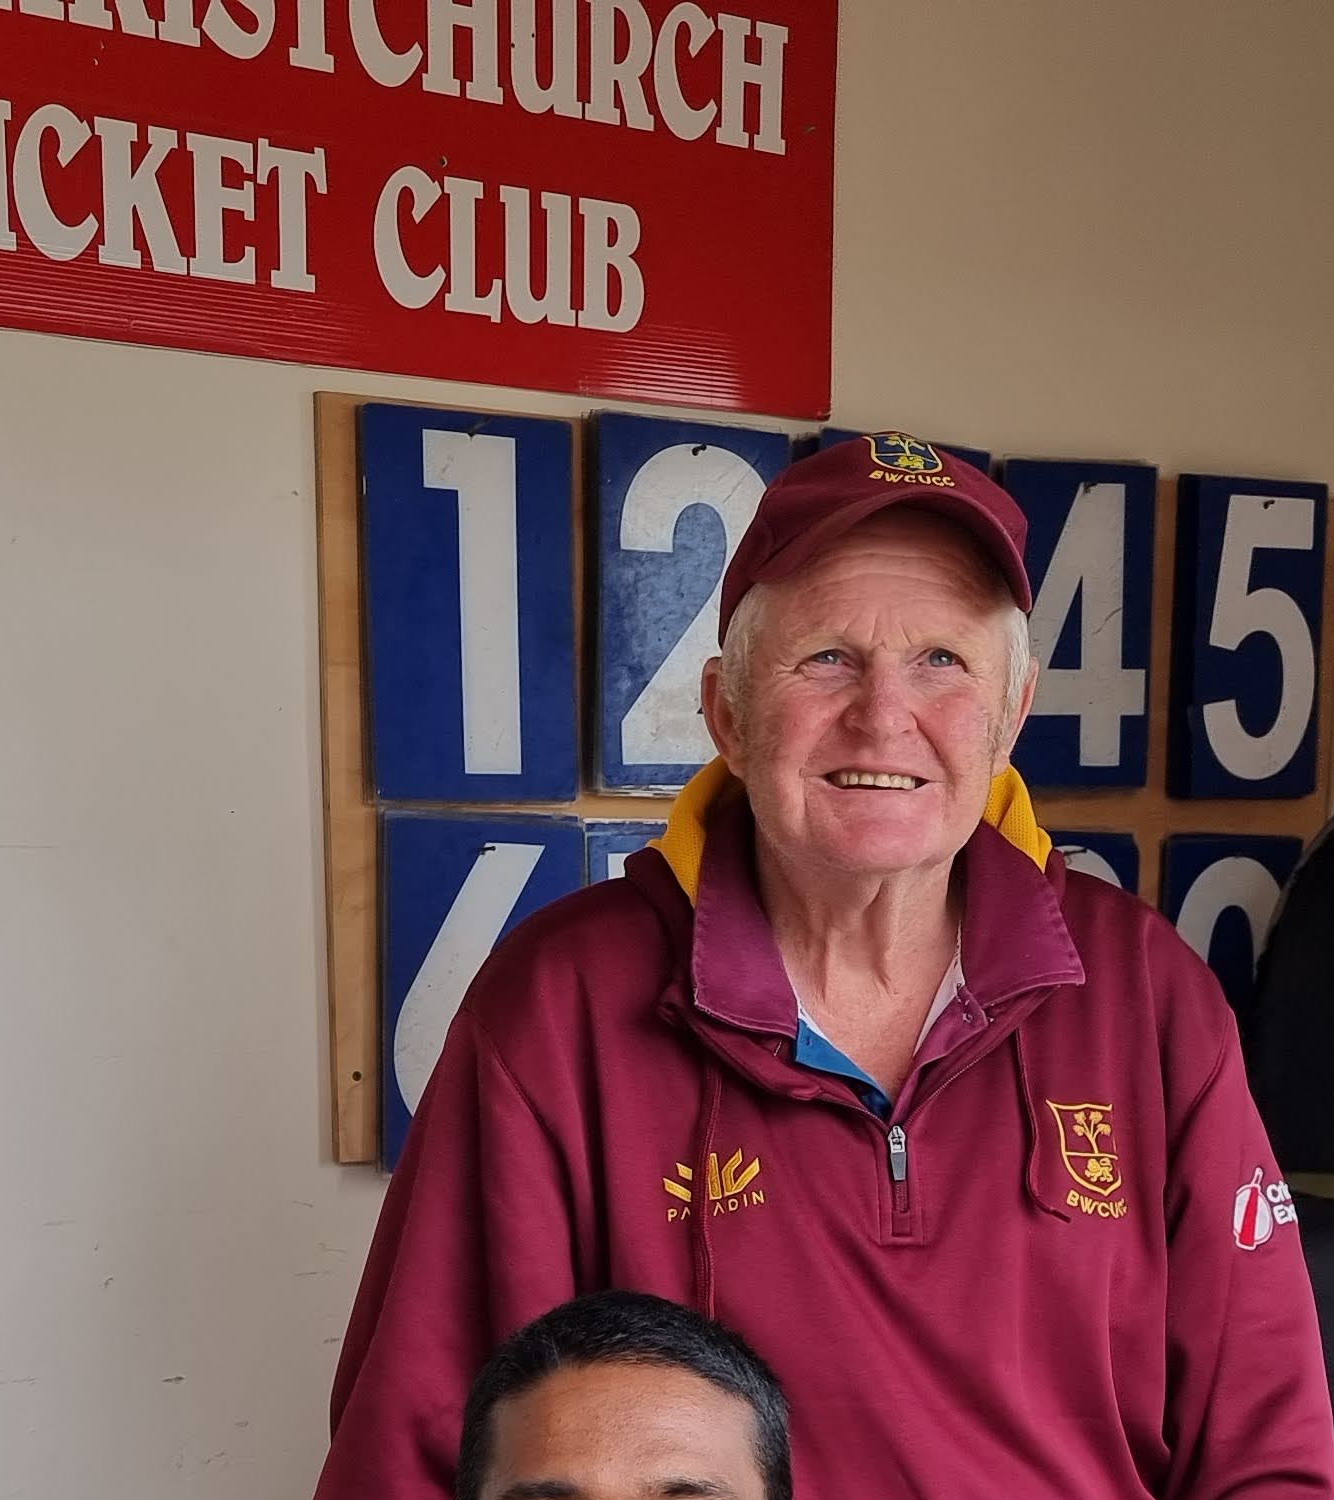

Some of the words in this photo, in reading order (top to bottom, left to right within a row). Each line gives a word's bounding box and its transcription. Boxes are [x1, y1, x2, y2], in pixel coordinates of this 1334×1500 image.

[373, 165, 645, 334] CLUB
[869, 470, 956, 488] BWCUCC
[421, 428, 522, 776] 1
[618, 442, 768, 766] 2
[1027, 481, 1147, 768] 4
[1200, 494, 1316, 782] 5
